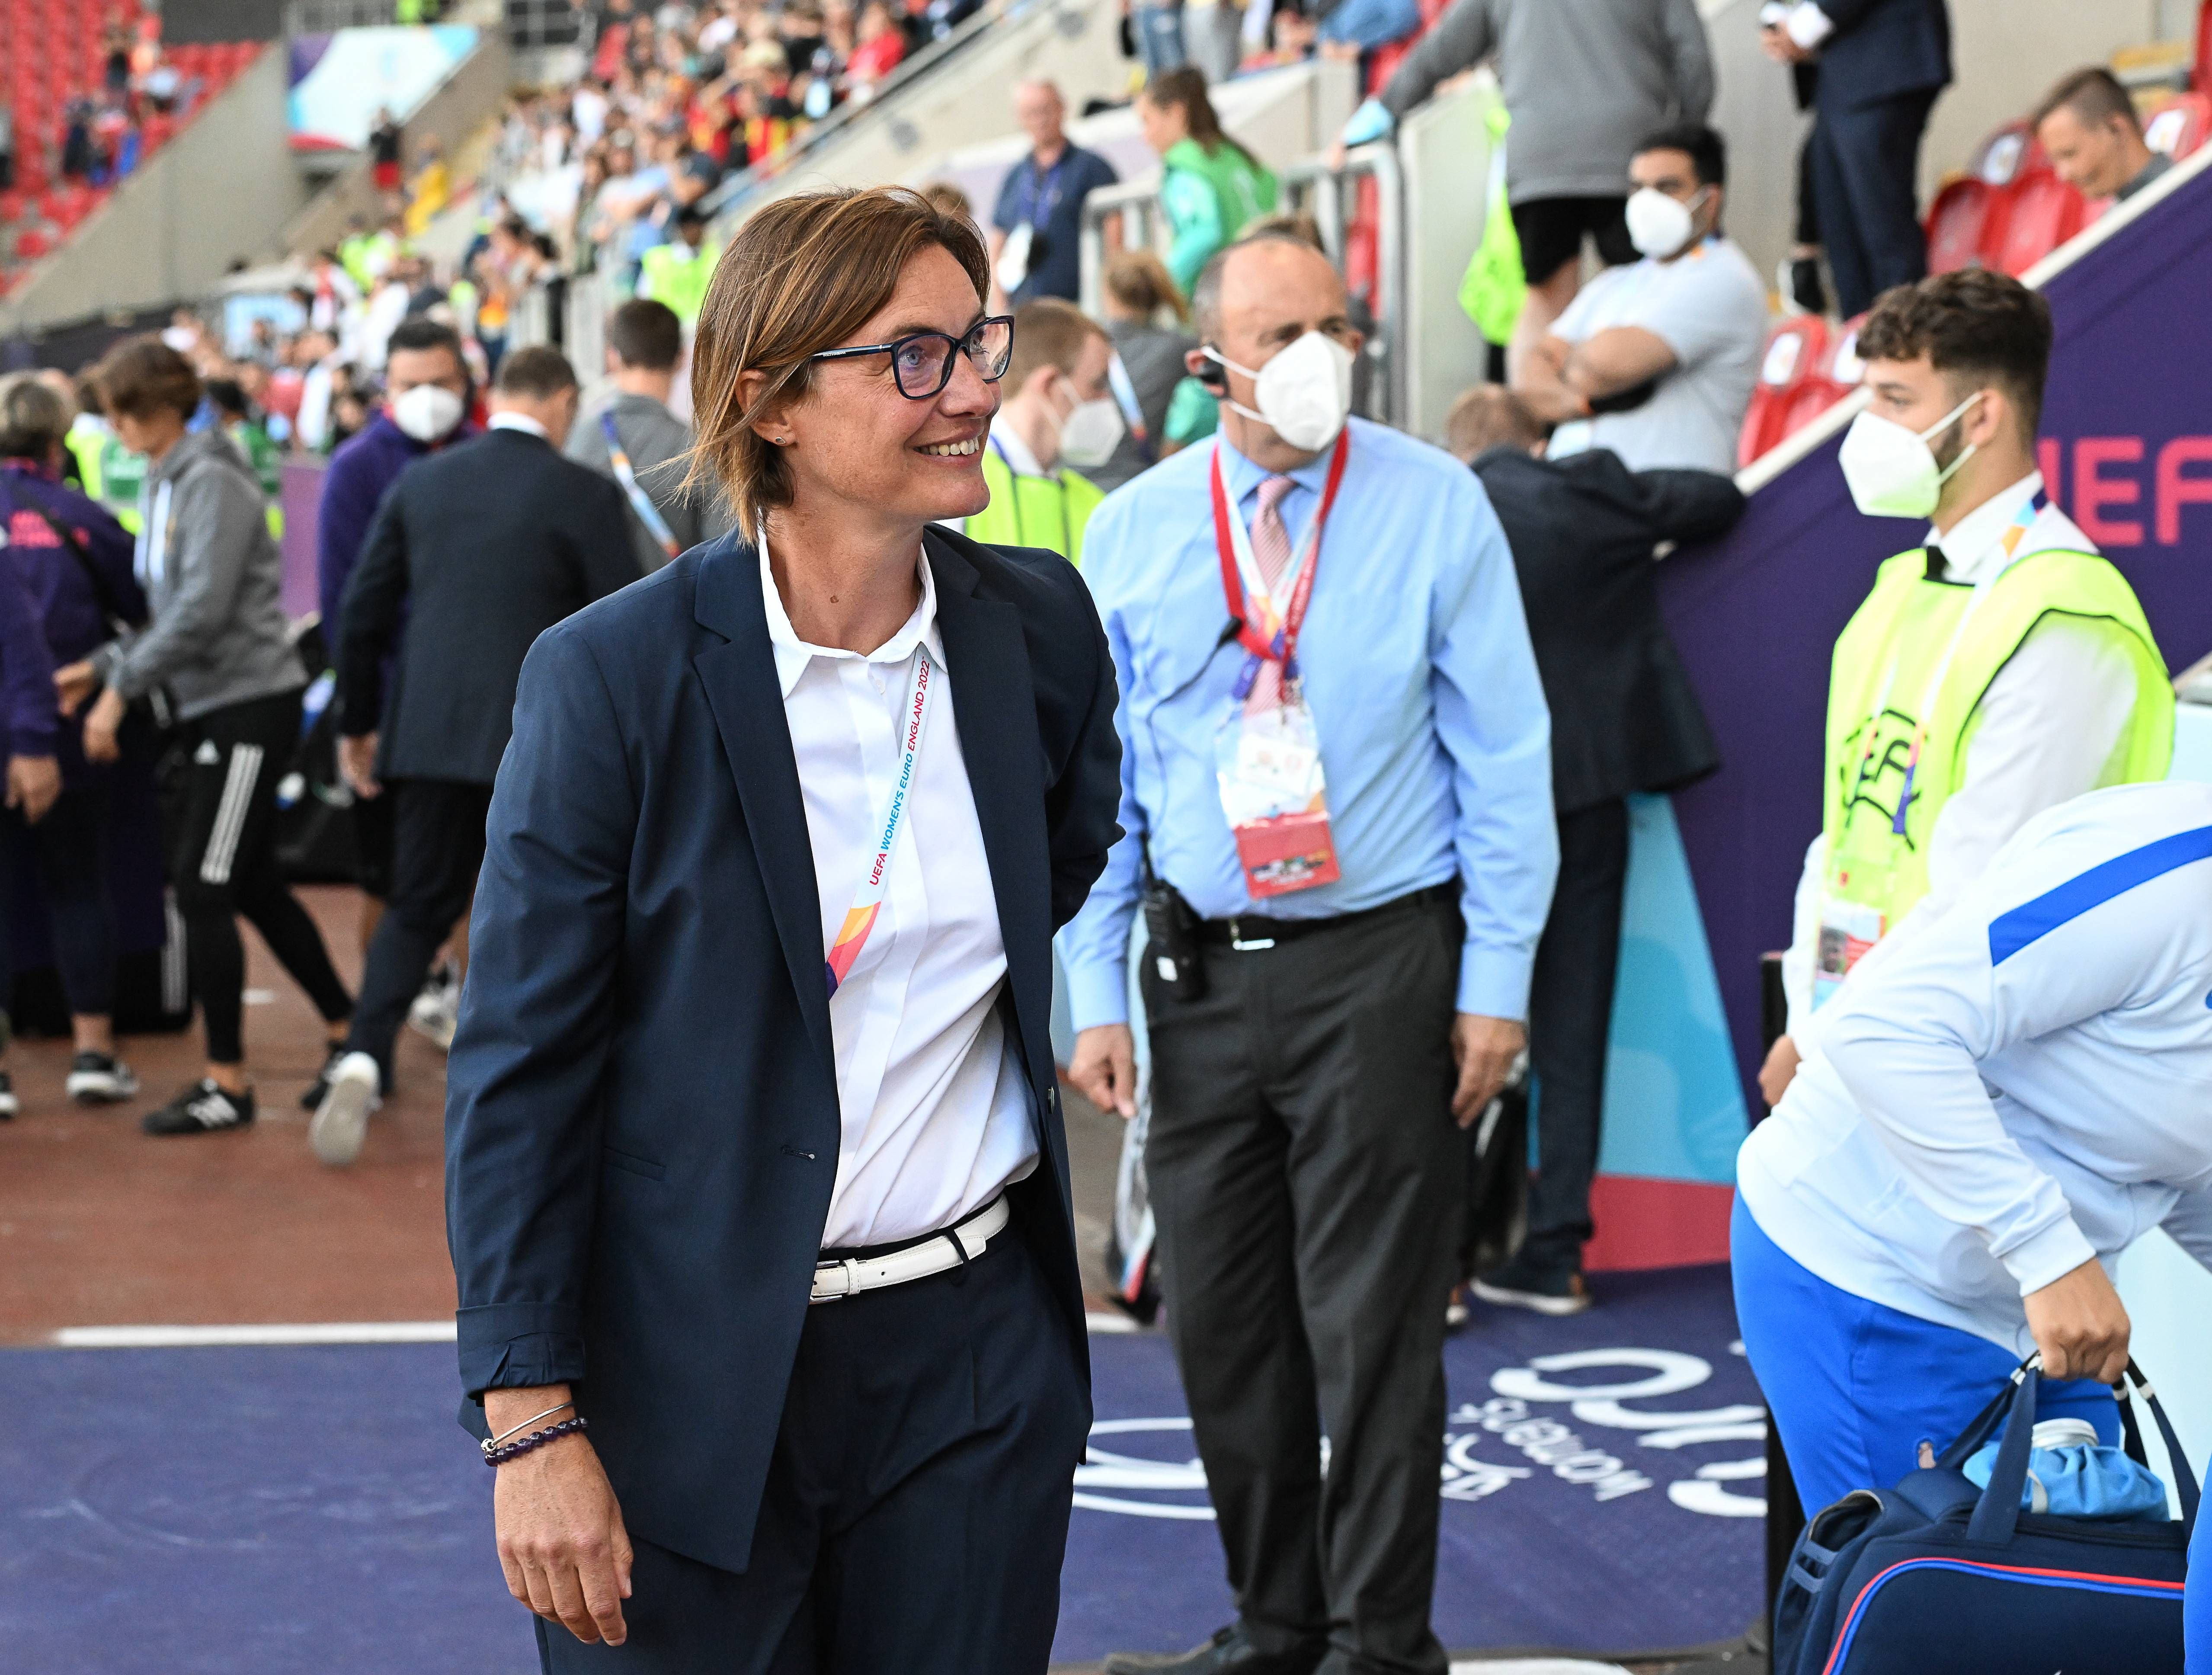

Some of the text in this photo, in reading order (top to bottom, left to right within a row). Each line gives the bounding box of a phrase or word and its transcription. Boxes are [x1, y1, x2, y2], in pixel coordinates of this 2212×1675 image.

[870, 853, 887, 886] UEFA
[880, 790, 905, 850] WOMEN'S
[899, 753, 913, 790] EURO
[908, 691, 924, 752] ENGLAND
